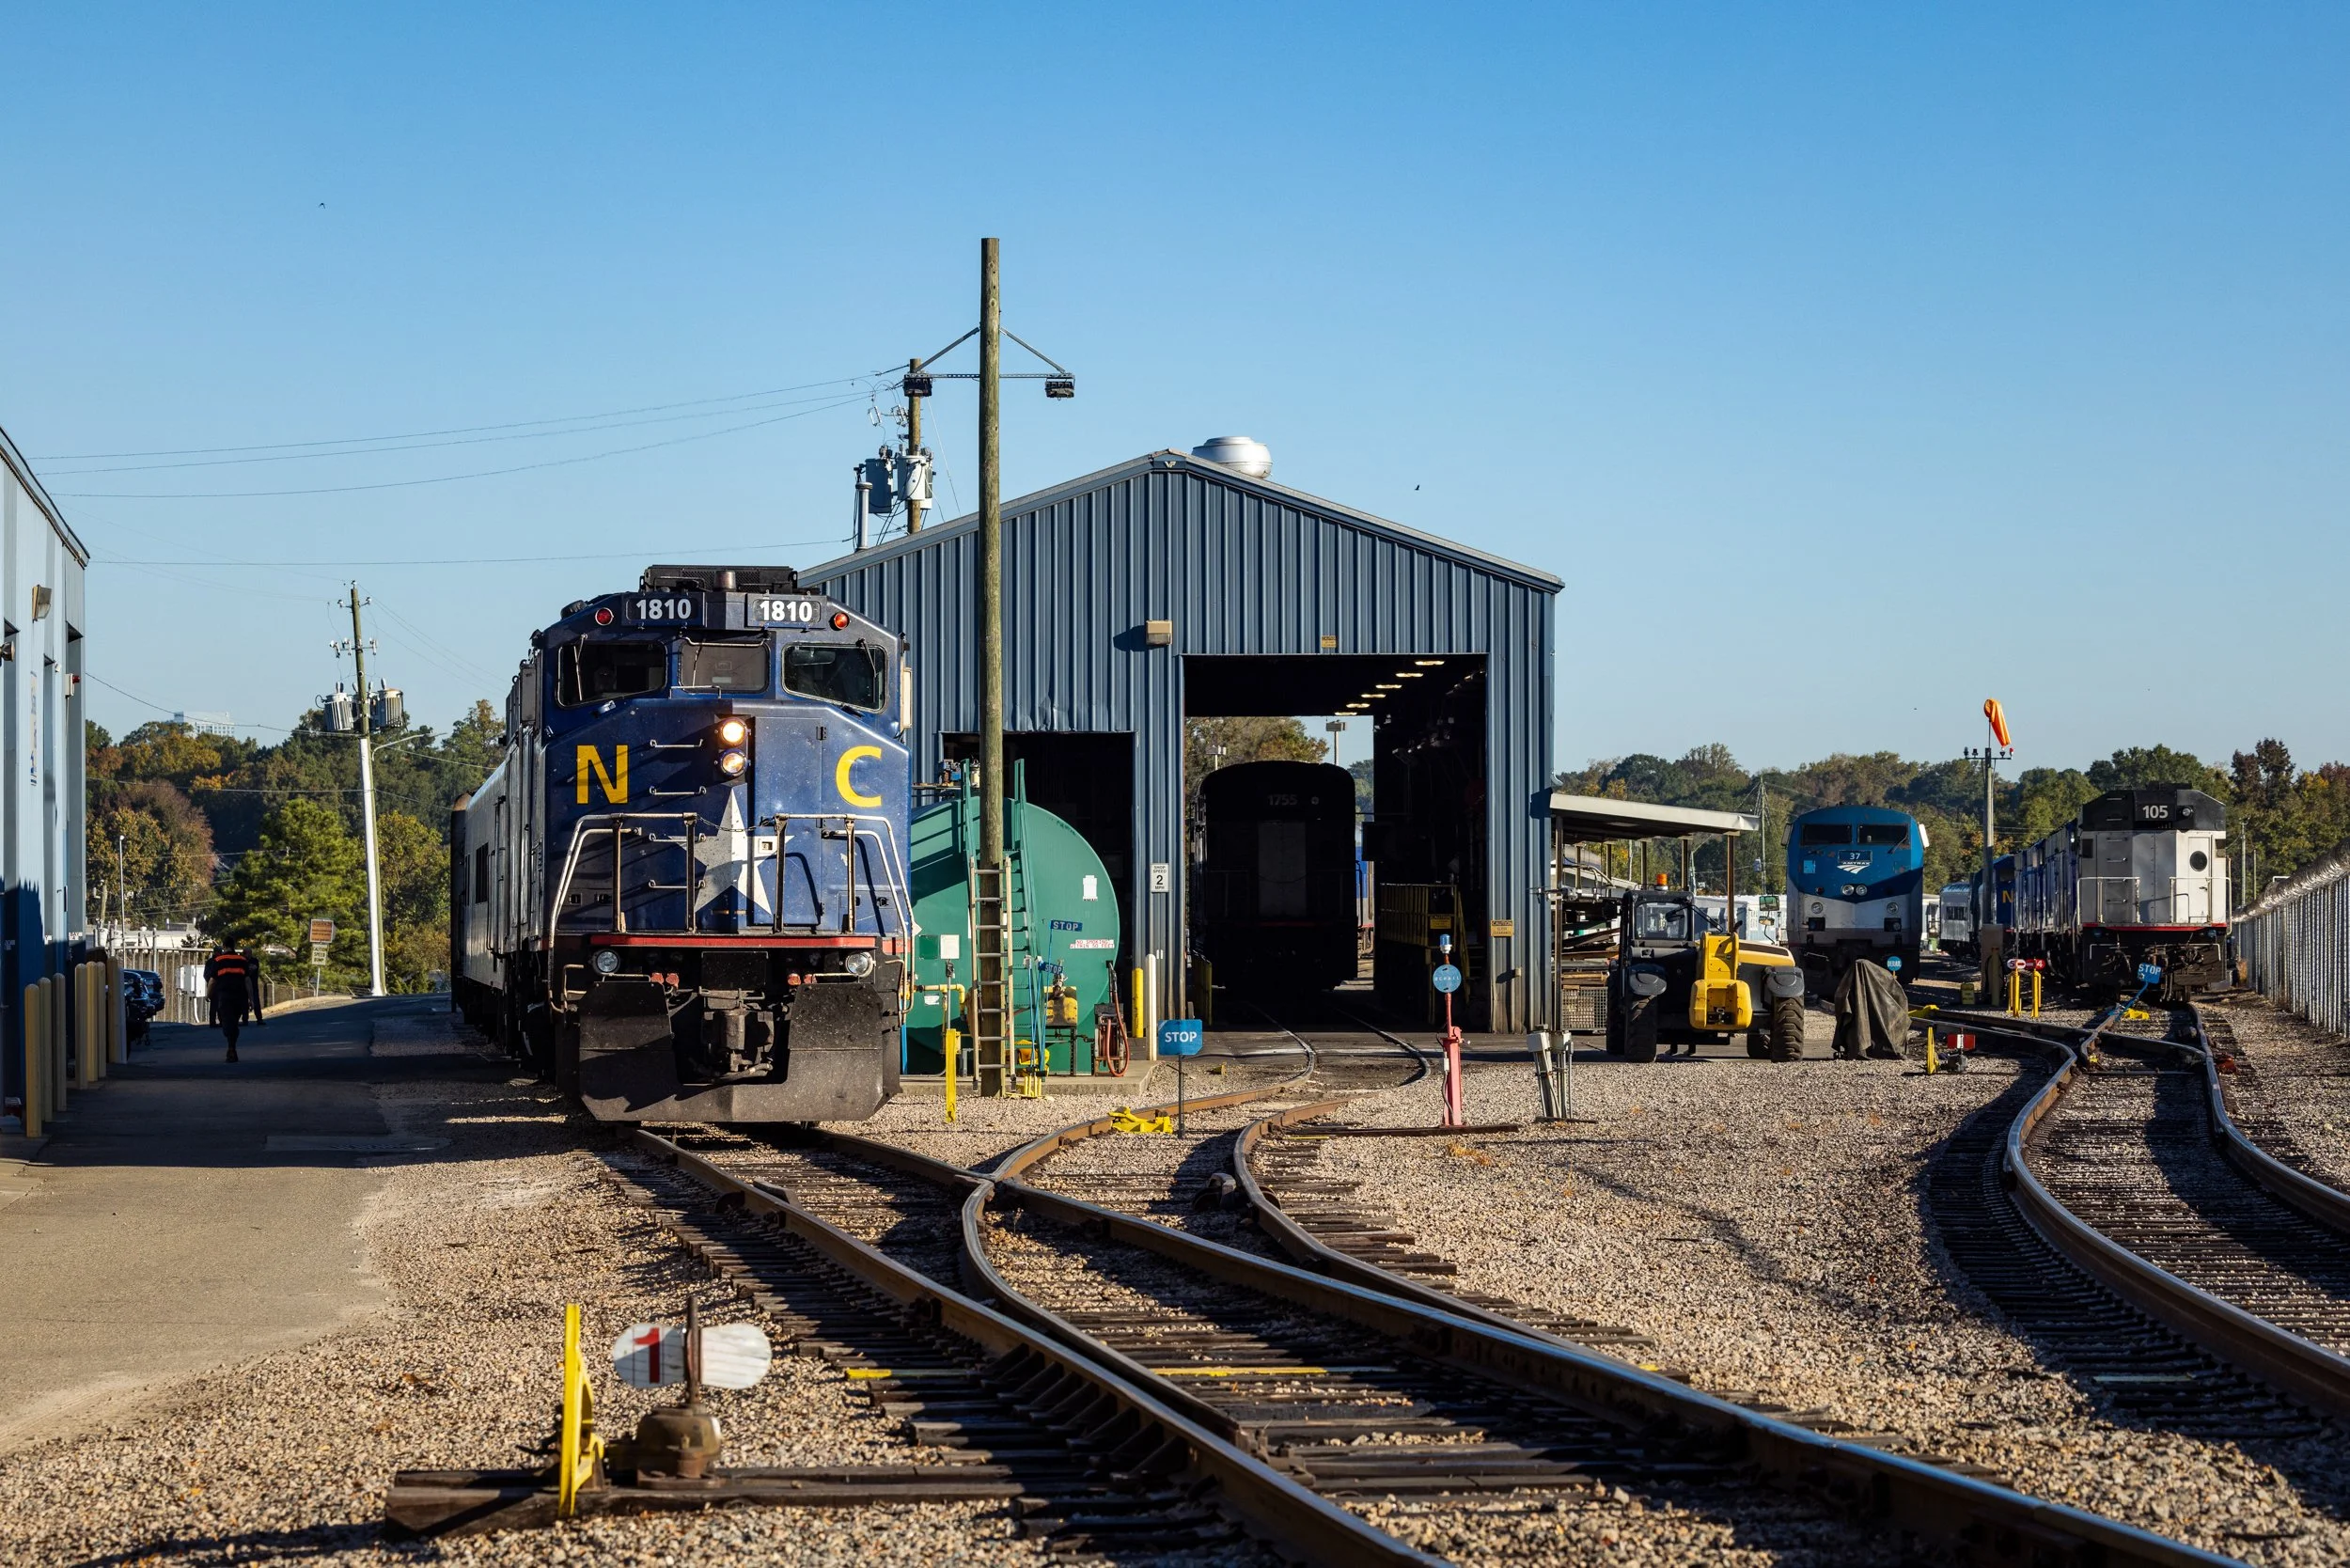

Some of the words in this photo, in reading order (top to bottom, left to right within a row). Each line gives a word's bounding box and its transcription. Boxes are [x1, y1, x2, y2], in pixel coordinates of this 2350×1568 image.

[636, 599, 692, 619] 1810
[760, 600, 813, 622] 1810
[577, 745, 628, 804] N
[835, 745, 882, 808] C
[1268, 794, 1297, 806] 1755
[2142, 805, 2169, 819] 105
[1849, 852, 1860, 860] 37
[1156, 874, 1164, 885] 2
[2002, 890, 2014, 903] N
[1053, 921, 1079, 931] STOP
[1044, 964, 1062, 974] STOP
[2036, 960, 2043, 968] 4
[2138, 964, 2162, 975] STOP
[1165, 1031, 1198, 1043] STOP
[634, 1326, 661, 1384] 1
